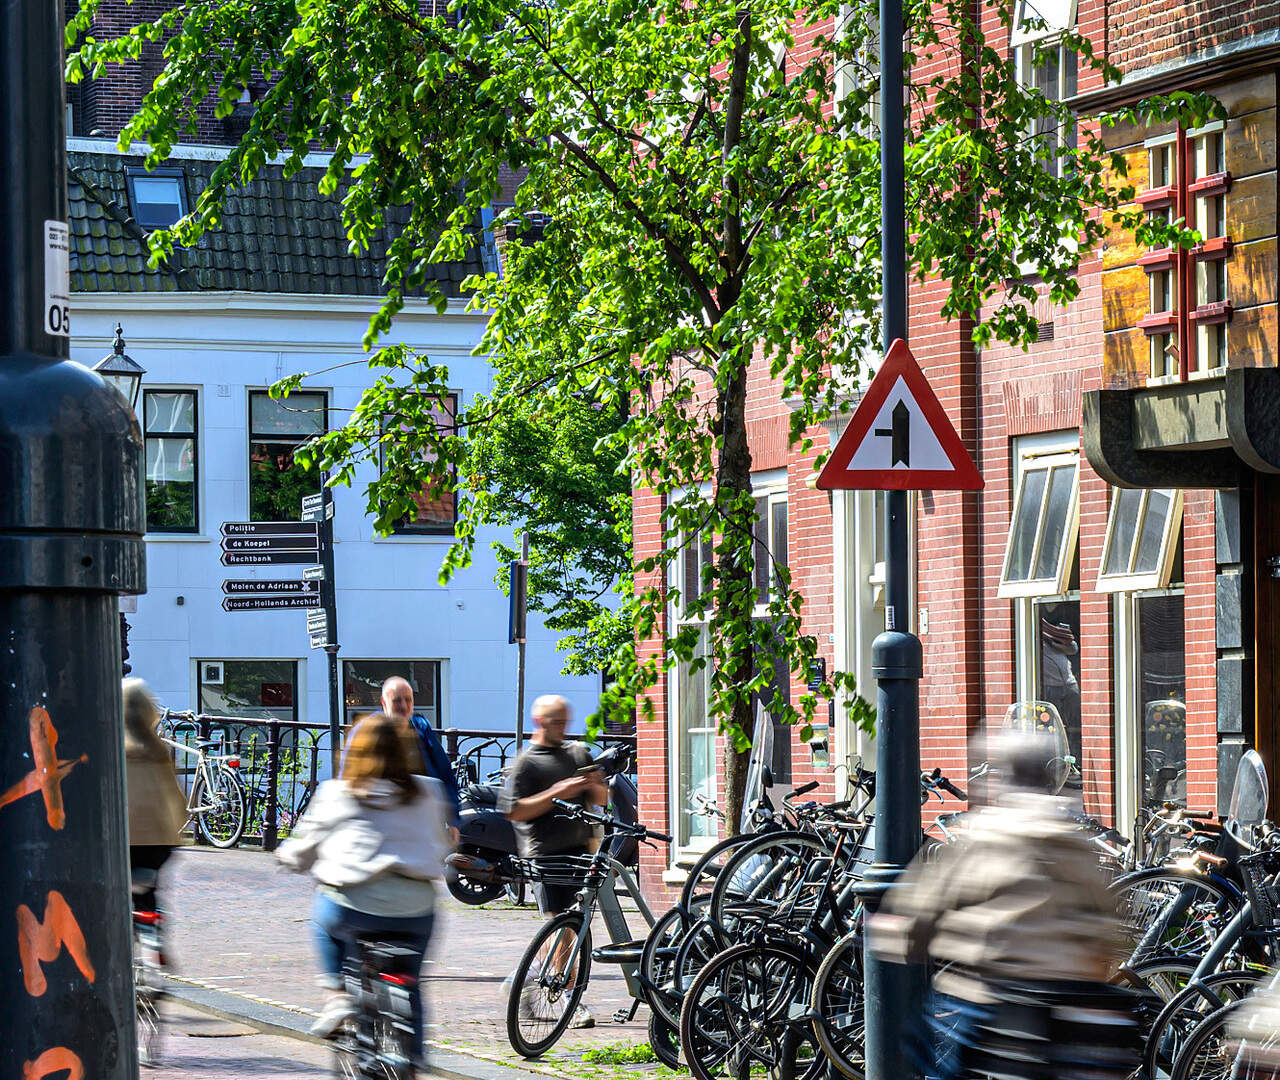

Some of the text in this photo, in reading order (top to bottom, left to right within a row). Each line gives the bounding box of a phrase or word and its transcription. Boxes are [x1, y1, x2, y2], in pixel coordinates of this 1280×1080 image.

[229, 524, 256, 533] Politie
[244, 539, 270, 548] Koepel
[230, 554, 272, 563] Rechtbank
[231, 583, 254, 591] Molen
[267, 582, 299, 590] Adriaan
[227, 597, 320, 608] Noord-Hollands Archief
